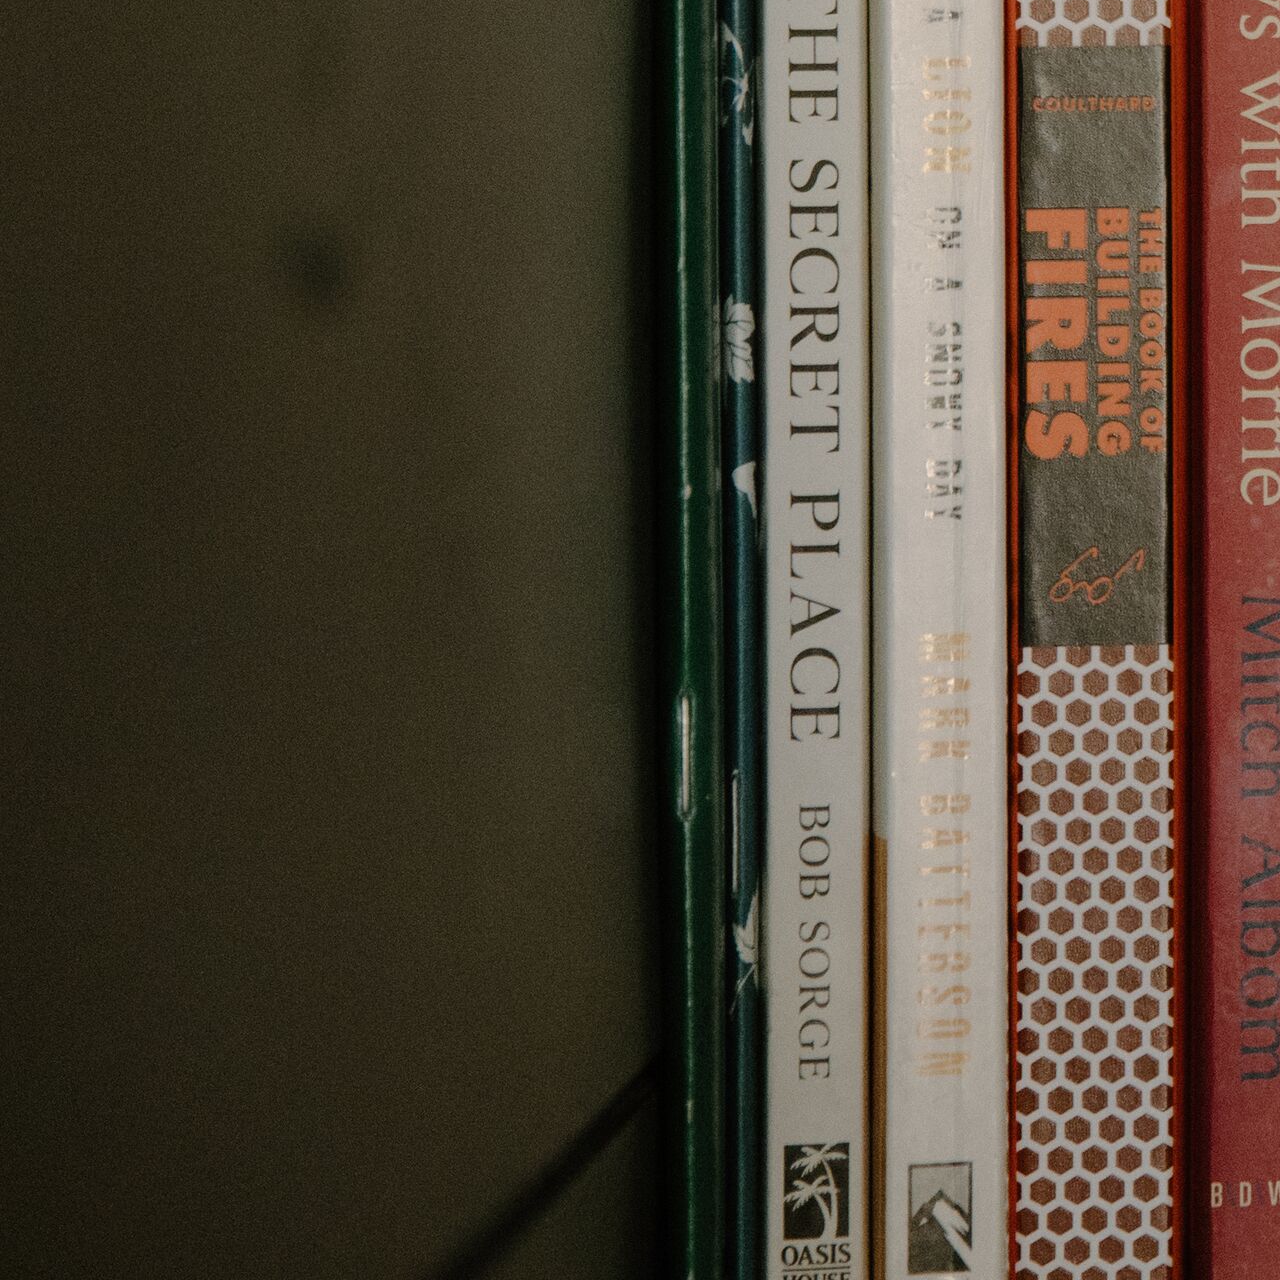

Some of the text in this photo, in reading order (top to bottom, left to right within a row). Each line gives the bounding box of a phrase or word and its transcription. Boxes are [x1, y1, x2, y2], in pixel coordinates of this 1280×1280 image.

[920, 55, 971, 174] LION
[1032, 96, 1154, 112] COULTHARD
[787, 158, 839, 453] SECRET
[923, 322, 962, 431] SNOWY
[1023, 207, 1088, 460] FIRES
[1094, 207, 1130, 458] BUILDING
[1138, 208, 1164, 455] THE BOOK OF
[923, 460, 963, 520] DAY
[788, 489, 839, 742] PLACE
[797, 805, 830, 1080] BOB SORGE
[914, 632, 971, 1078] MARK BATTERSON
[781, 1243, 850, 1266] OASIS
